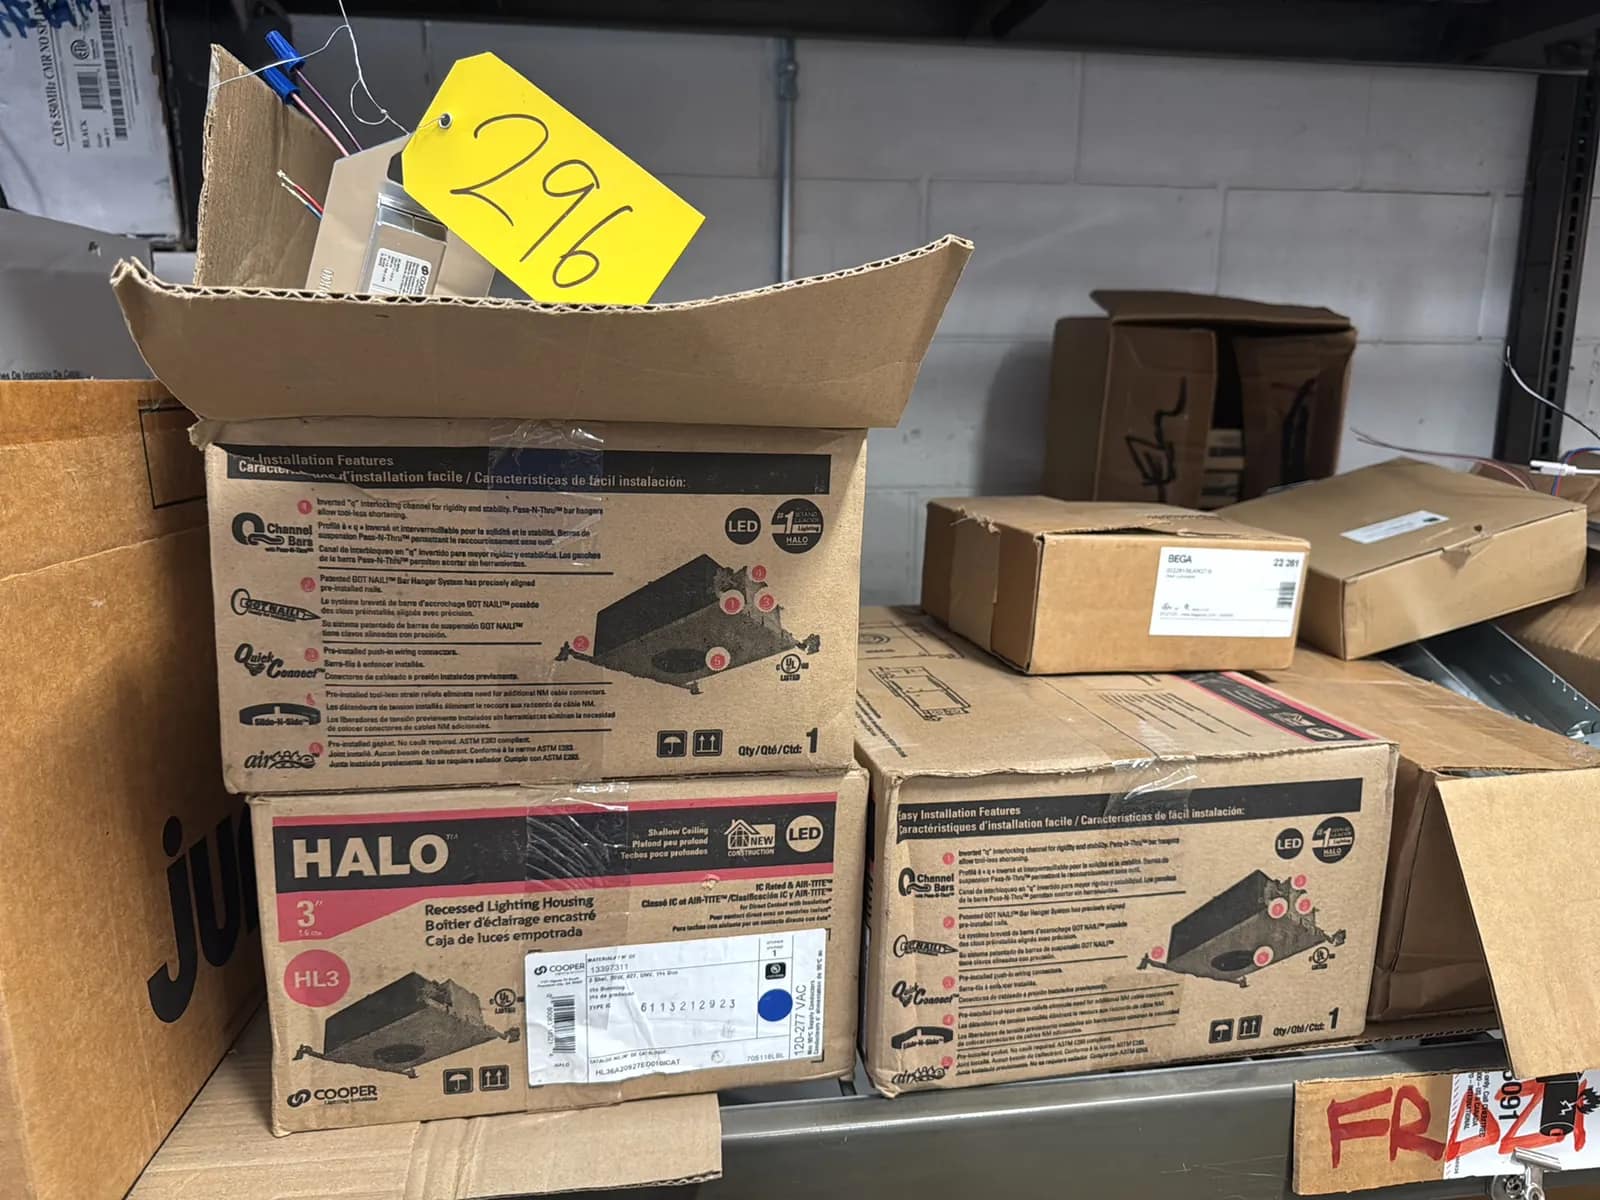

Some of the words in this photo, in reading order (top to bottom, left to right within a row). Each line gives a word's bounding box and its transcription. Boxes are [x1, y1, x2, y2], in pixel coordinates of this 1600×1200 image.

[450, 114, 633, 288] 296
[259, 453, 334, 467] Installation
[337, 454, 394, 467] Features
[427, 471, 463, 483] facile
[572, 474, 586, 485] de
[619, 475, 686, 487] instalación:
[267, 523, 313, 535] Channel
[728, 520, 758, 533] LED
[288, 536, 314, 546] Bars
[786, 536, 809, 544] HALO
[1168, 554, 1193, 564] BEGA
[1273, 558, 1285, 567] 22
[806, 727, 818, 754] 1
[921, 806, 976, 820] Installation
[979, 806, 1021, 818] Features
[979, 818, 1043, 831] d'installation
[1045, 816, 1073, 828] facile
[1155, 811, 1166, 821] de
[1168, 808, 1189, 820] fácil
[1191, 807, 1245, 818] instalación:
[648, 828, 681, 837] Shallow
[682, 826, 709, 837] Ceiling
[789, 827, 821, 841] LED
[632, 839, 662, 848] Plafond
[664, 839, 678, 848] peu
[679, 837, 708, 848] profond
[750, 835, 774, 846] NEW
[1278, 838, 1302, 850] LED
[728, 848, 775, 857] CONSTRUCTION
[917, 873, 954, 883] Channel
[756, 883, 764, 891] IC
[765, 882, 787, 891] Rated
[787, 882, 794, 890] &
[934, 884, 954, 892] Bars
[425, 901, 484, 916] Recessed
[487, 899, 540, 914] Lighting
[543, 896, 594, 910] Housing
[641, 898, 668, 909] Classé
[669, 898, 678, 907] IC
[679, 898, 687, 906] et
[780, 891, 788, 899] IC
[789, 892, 794, 900] y
[425, 916, 471, 932] Boîtier
[474, 913, 540, 928] d'éclairage
[543, 909, 596, 924] encastré
[426, 935, 454, 949] Caja
[458, 933, 474, 945] de
[478, 931, 509, 944] luces
[513, 927, 583, 943] empotrada
[549, 963, 585, 973] COOPER
[294, 970, 340, 988] HL3
[795, 984, 807, 1010] VAC
[640, 999, 736, 1013] 6113212923
[1329, 1007, 1339, 1029] 1
[794, 1014, 806, 1056] 120-277
[314, 1085, 378, 1100] COOPER
